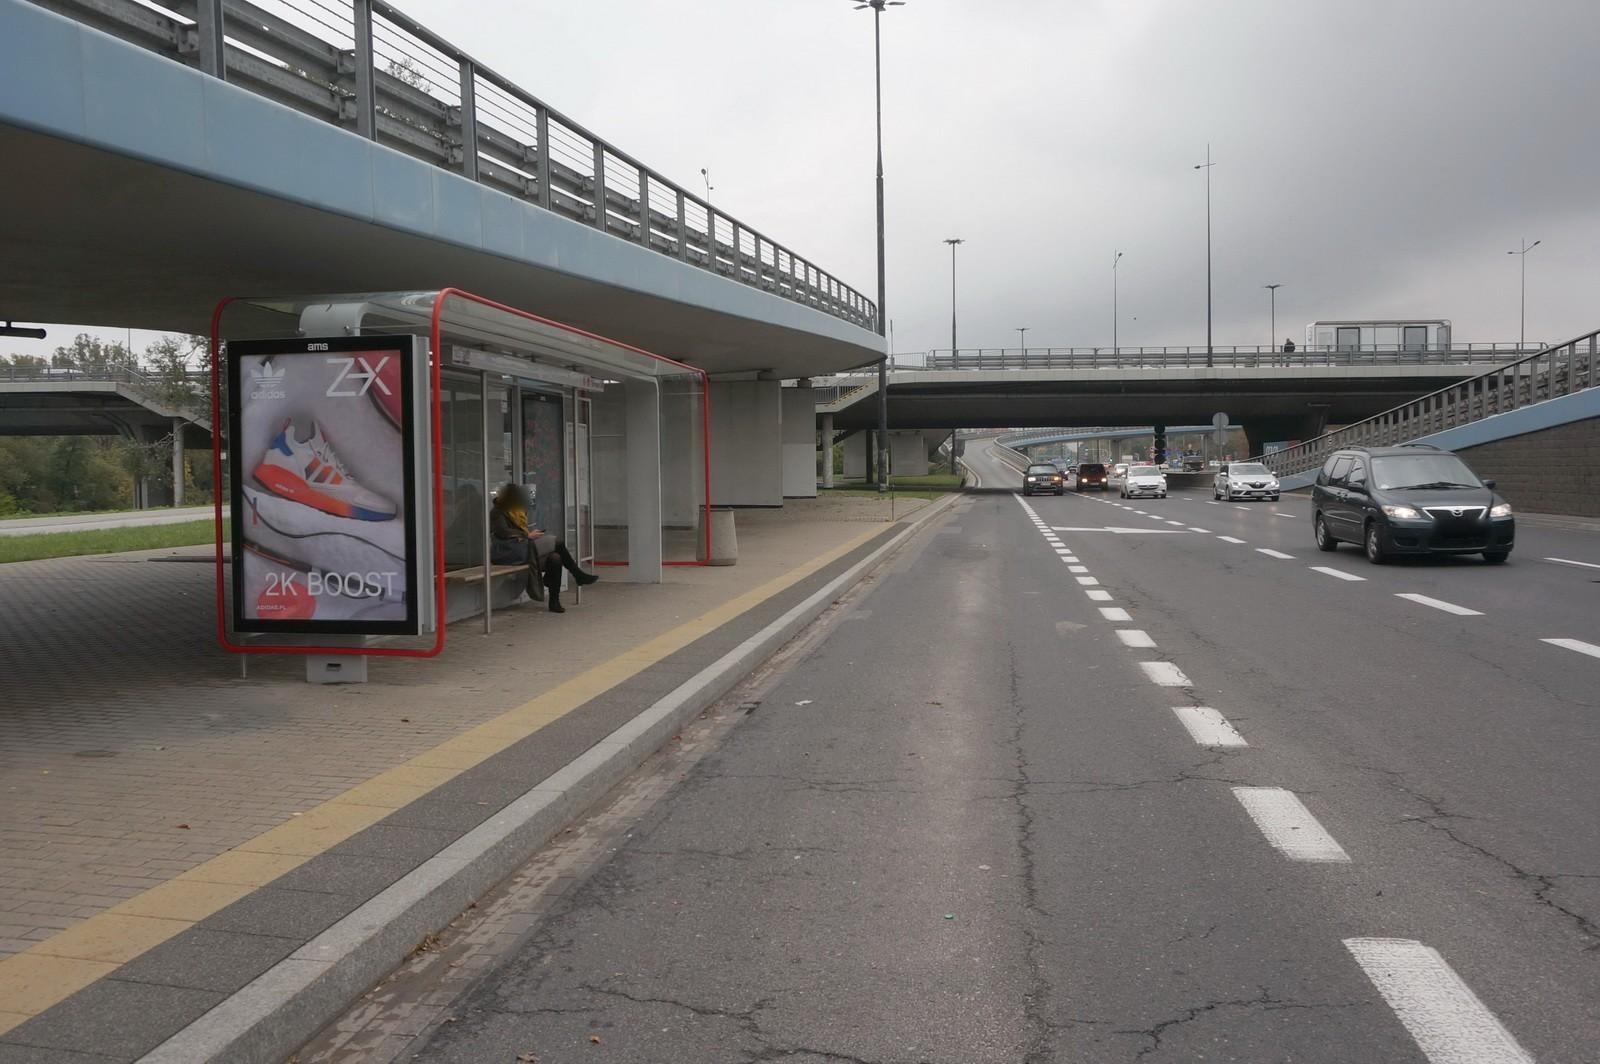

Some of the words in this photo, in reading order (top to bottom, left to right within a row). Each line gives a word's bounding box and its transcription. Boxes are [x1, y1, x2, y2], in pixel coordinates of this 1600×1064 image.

[307, 343, 329, 351] ams
[250, 390, 286, 400] adidas
[265, 572, 298, 597] 2K
[307, 571, 398, 597] BOOST
